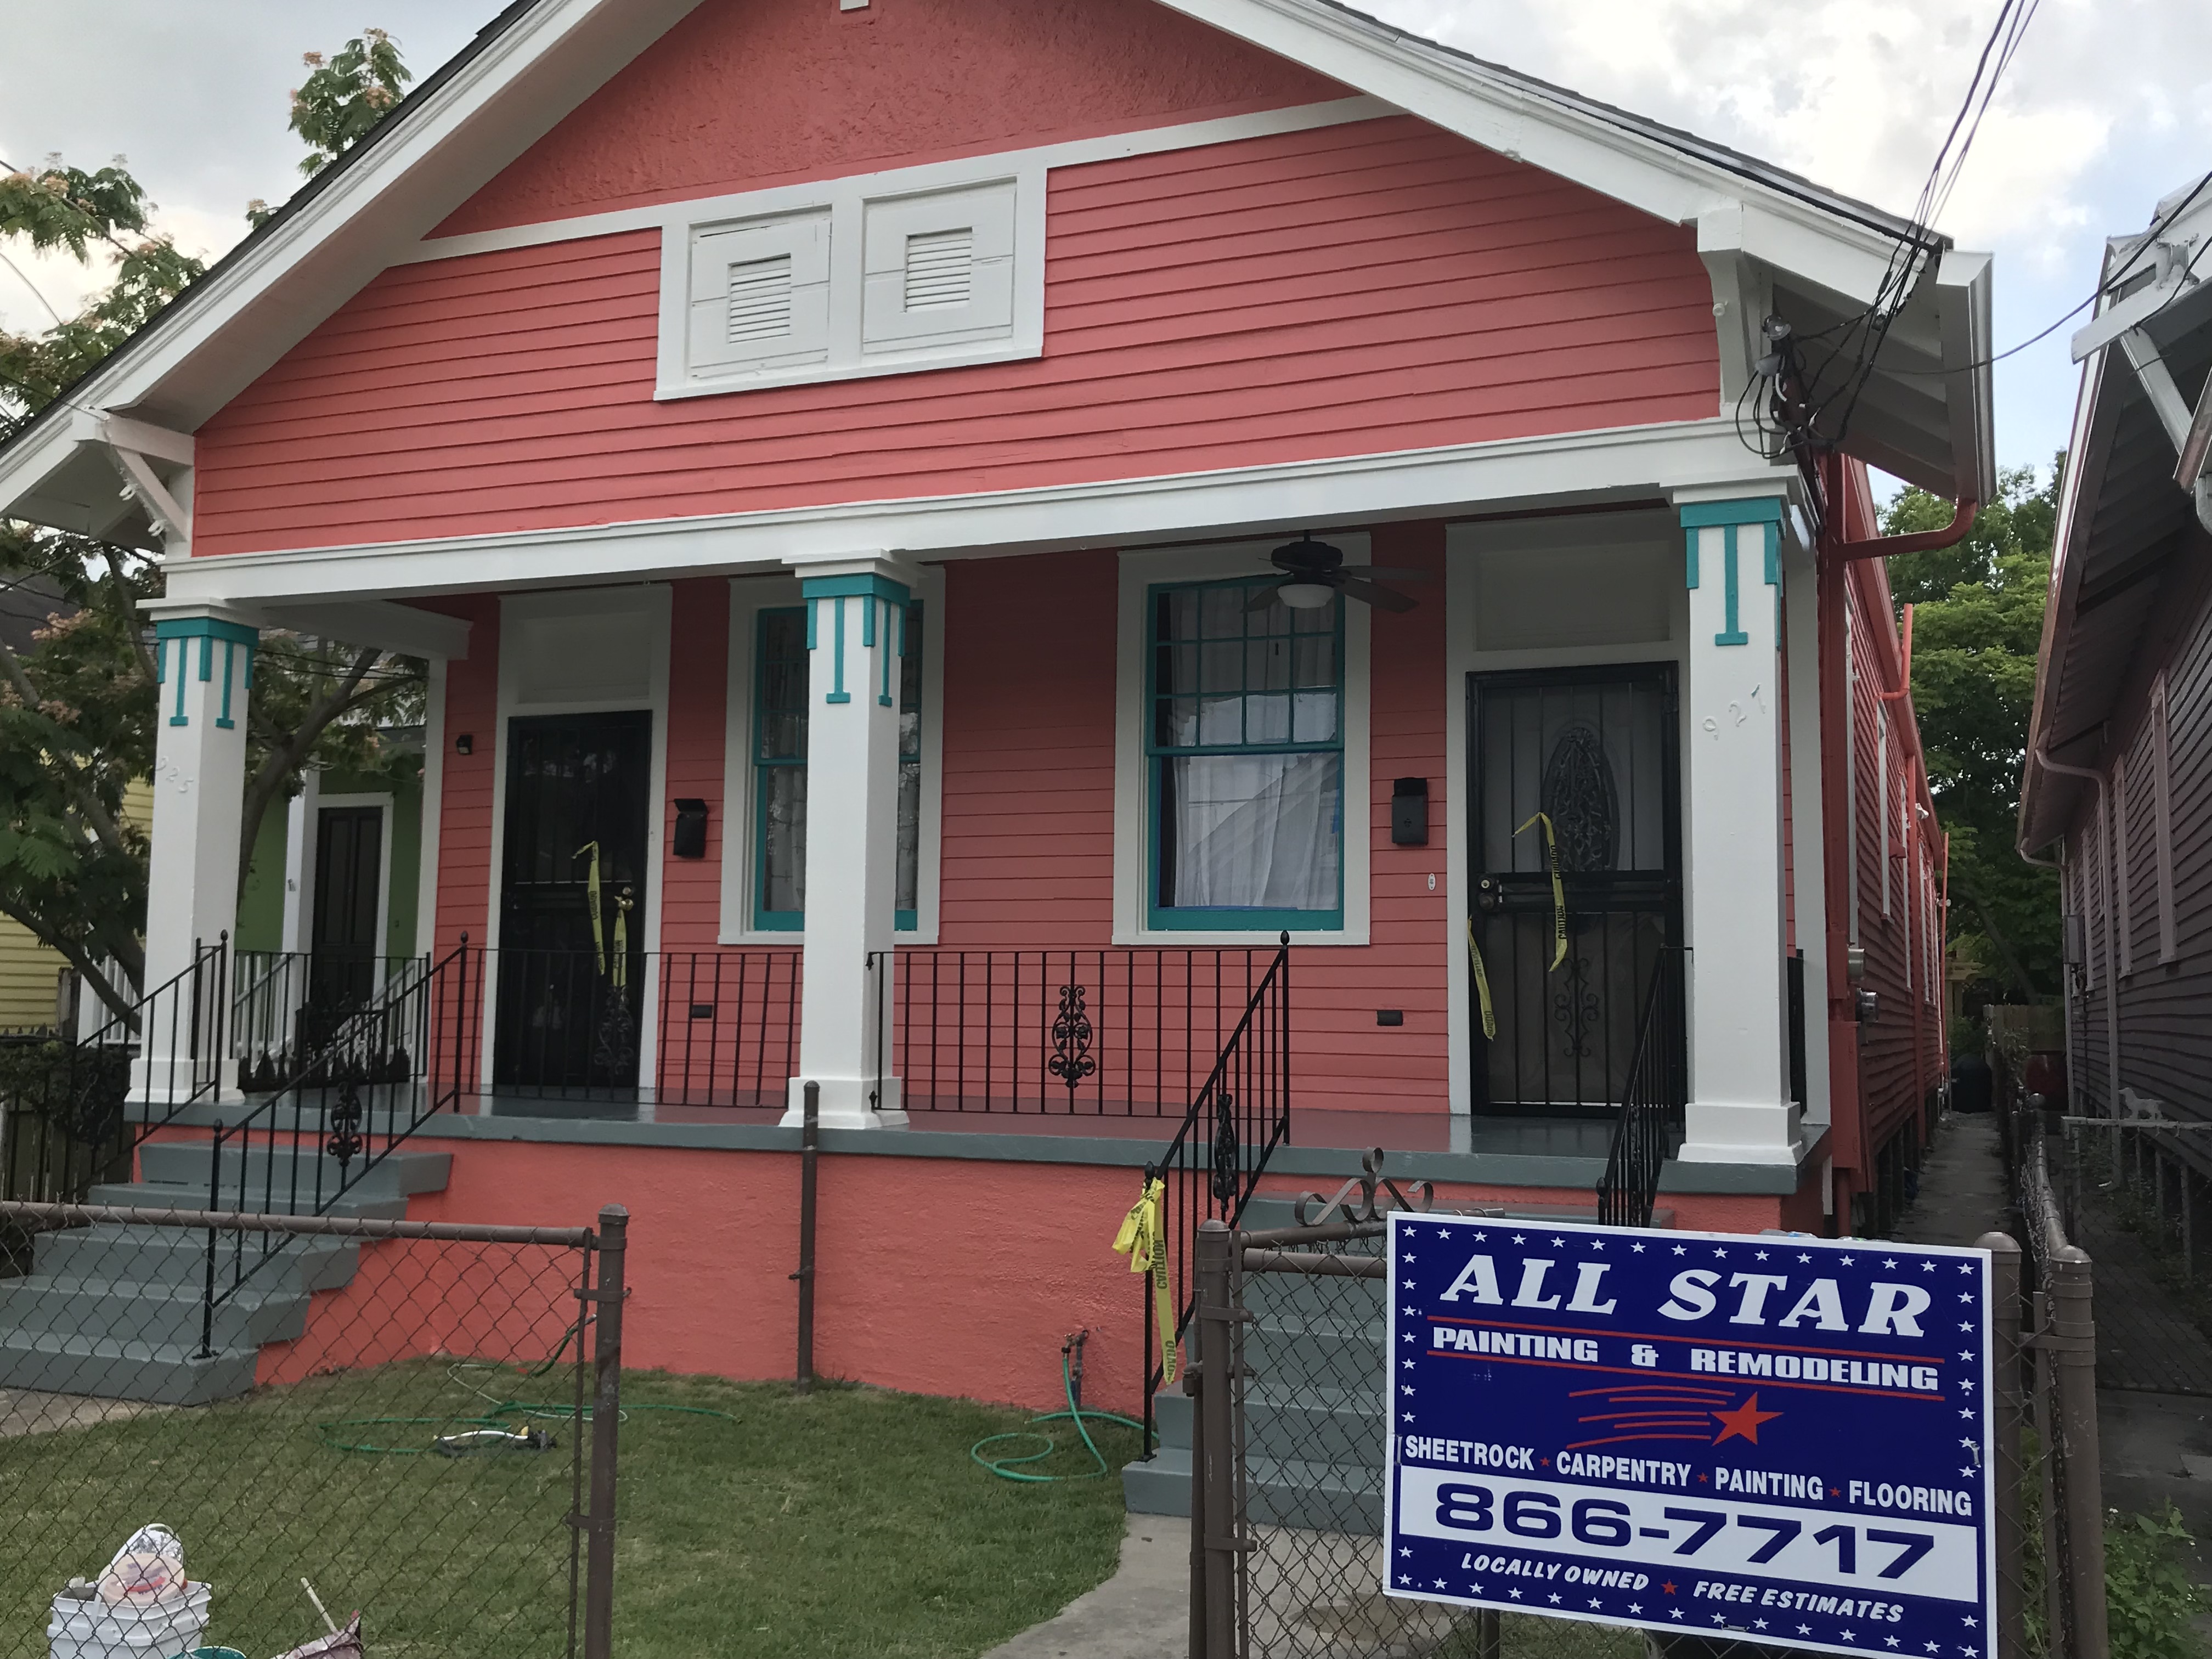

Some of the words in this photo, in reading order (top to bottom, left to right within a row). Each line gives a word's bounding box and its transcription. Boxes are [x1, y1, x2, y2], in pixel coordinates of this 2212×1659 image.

[1555, 905, 1567, 940] CAUTION
[1440, 1254, 1617, 1314] ALL
[1657, 1269, 1931, 1337] STAR
[1433, 1327, 1599, 1362] PAINTING
[1631, 1344, 1659, 1367] &
[1691, 1348, 1938, 1391] REMODELING
[1404, 1435, 1534, 1471] SHEETROCK
[1556, 1451, 1691, 1487] CARPENTRY
[1715, 1466, 1824, 1500] PAINTING
[1849, 1480, 1972, 1516] FLOORING
[1435, 1482, 1934, 1579] 866-7717
[1461, 1553, 1562, 1581] LOCALLY
[1564, 1565, 1649, 1590] OWNED
[1693, 1581, 1758, 1604] FREE
[1760, 1588, 1904, 1622] ESTIMATES
